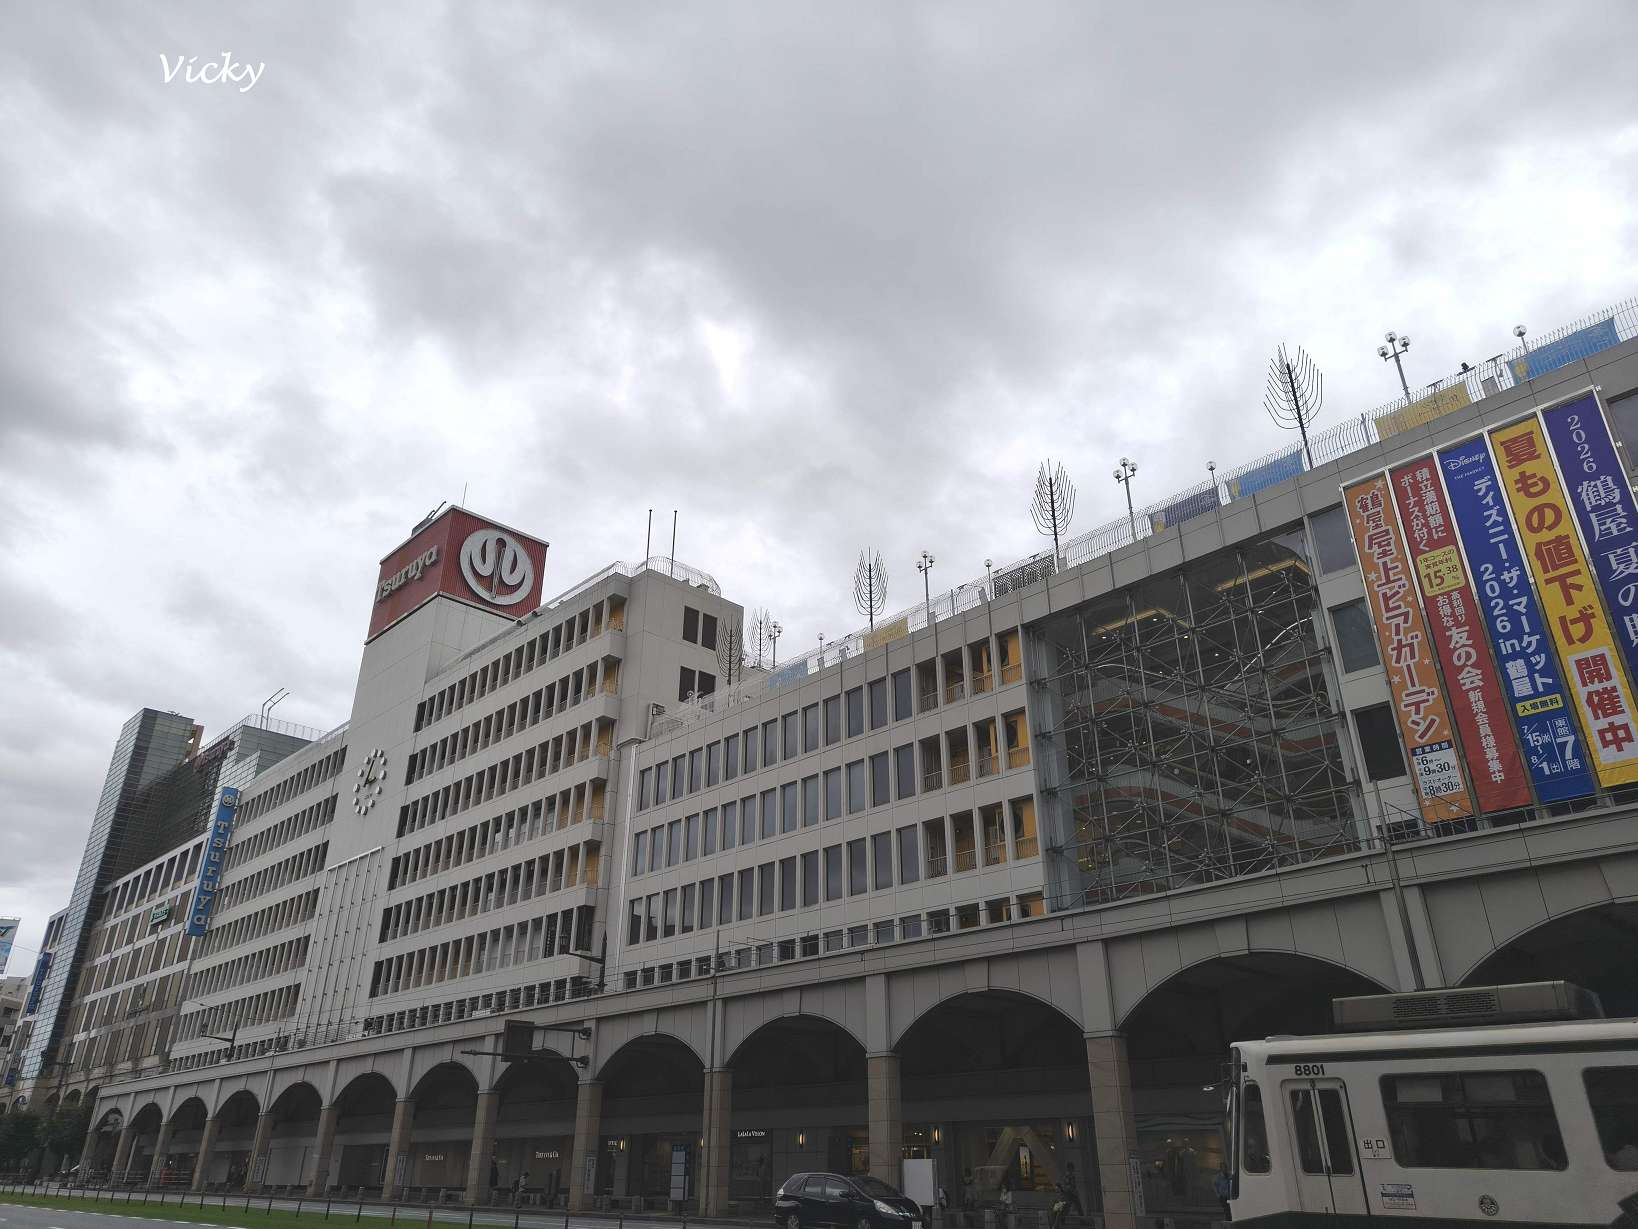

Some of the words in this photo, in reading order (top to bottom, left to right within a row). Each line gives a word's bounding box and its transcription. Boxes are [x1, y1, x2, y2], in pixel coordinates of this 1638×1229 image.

[1443, 453, 1486, 470] Disney
[1567, 414, 1596, 473] 2026
[1500, 430, 1597, 647] 夏もの値下げ
[376, 545, 438, 602] Tsuruya
[1480, 563, 1512, 633] 2026
[1446, 626, 1485, 690] 友の会
[1574, 652, 1635, 753] 開催中
[191, 819, 229, 926] Tsuruya
[1294, 1064, 1325, 1077] 8801
[1363, 1139, 1386, 1150] 出口
